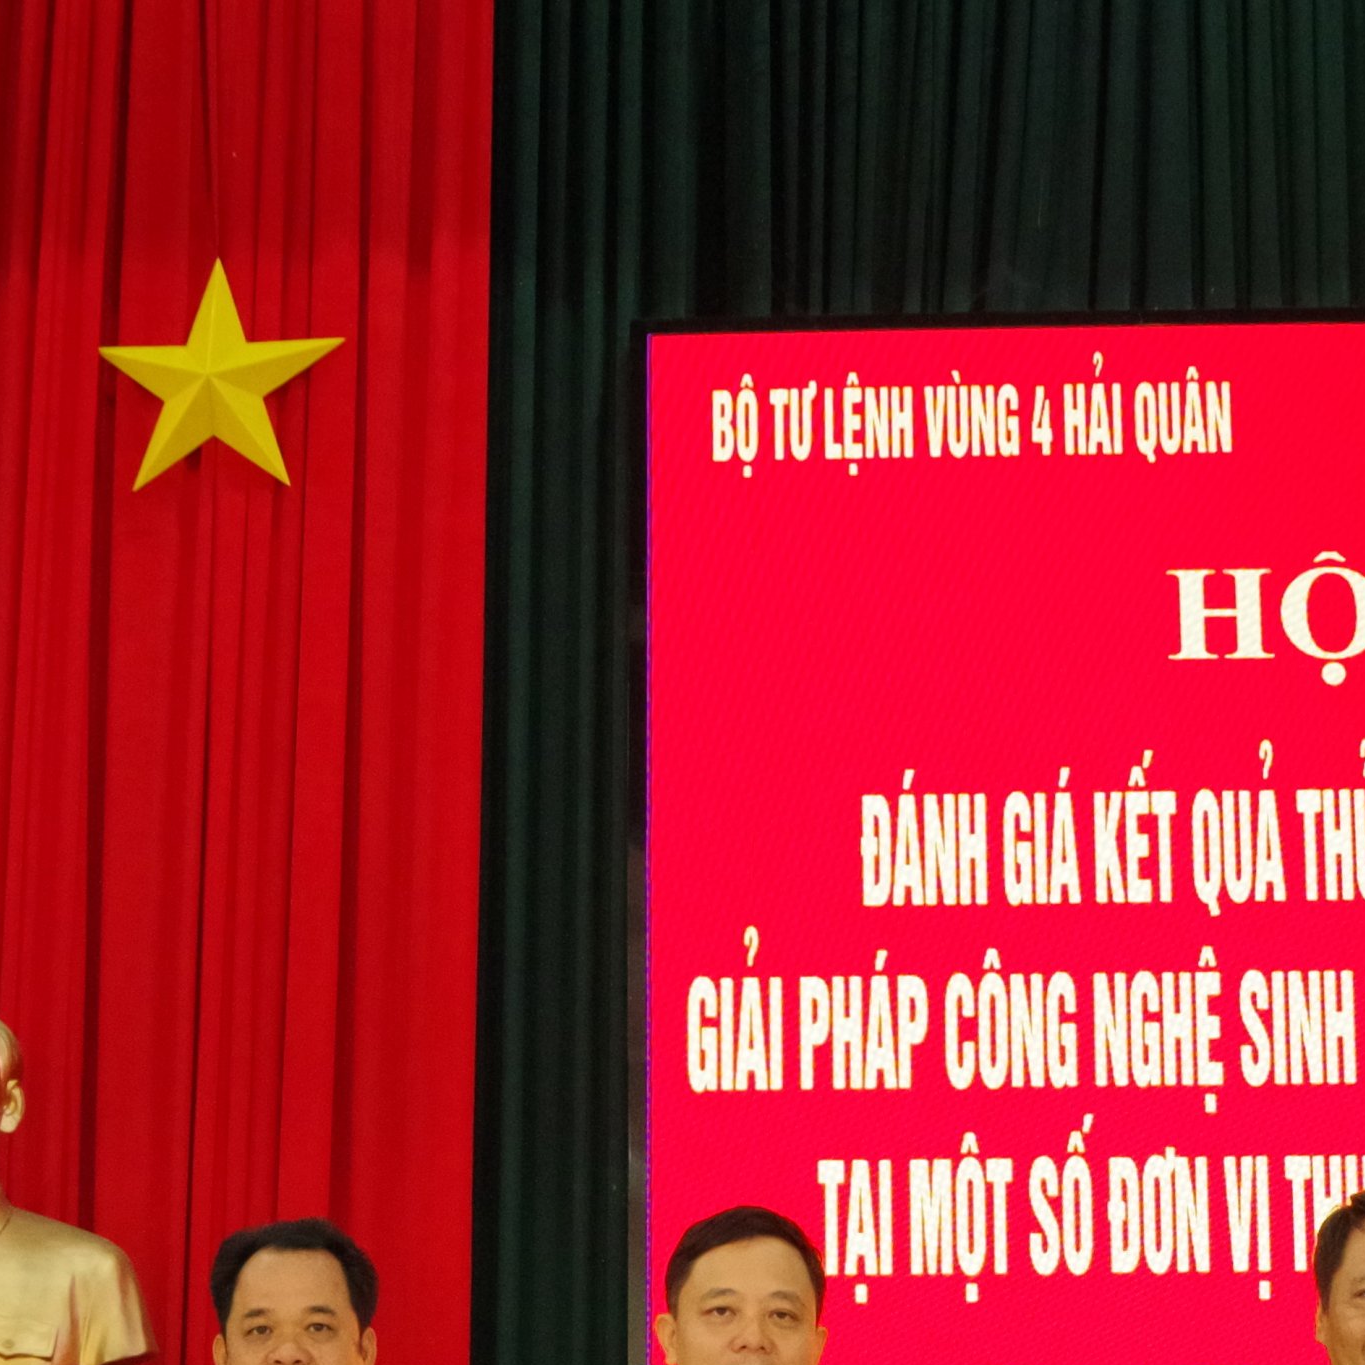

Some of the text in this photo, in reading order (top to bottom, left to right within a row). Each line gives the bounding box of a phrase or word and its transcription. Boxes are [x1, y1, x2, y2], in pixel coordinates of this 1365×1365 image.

[712, 352, 1232, 478] BỘ TƯ LỆNH VÙNG 4 HẢI QUÂN
[860, 769, 988, 906] ĐÁNH
[1003, 767, 1081, 906] GIÁ
[1094, 750, 1176, 903] KẾT
[1192, 740, 1286, 916] QUẢ
[687, 926, 783, 1093] GIẢI
[799, 950, 928, 1090] PHÁP
[945, 948, 1078, 1090] CÔNG
[1092, 946, 1223, 1113] NGHỆ
[1240, 970, 1357, 1087] SINH
[818, 1159, 892, 1304] TẠI
[909, 1132, 1013, 1303] MỘT
[1029, 1114, 1093, 1276] SỐ
[1107, 1148, 1210, 1275] ĐƠN
[1224, 1155, 1271, 1300] VỊ
